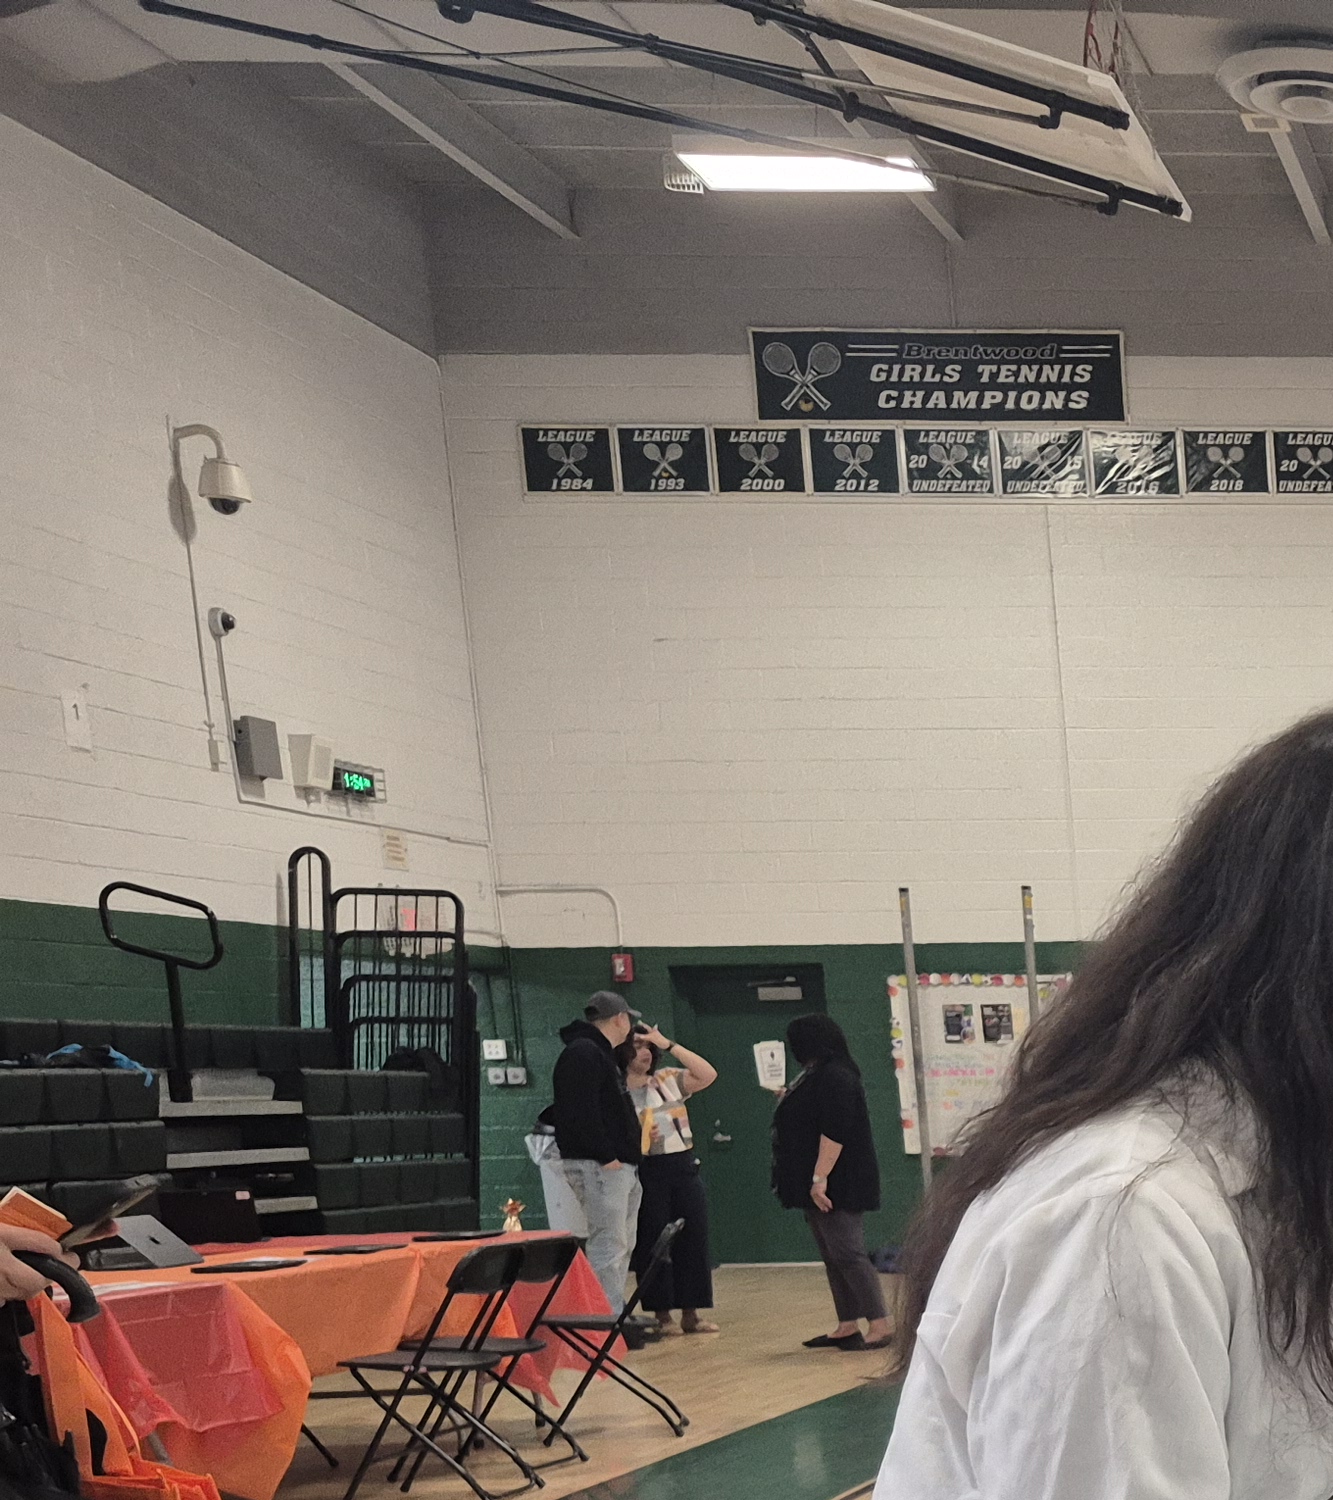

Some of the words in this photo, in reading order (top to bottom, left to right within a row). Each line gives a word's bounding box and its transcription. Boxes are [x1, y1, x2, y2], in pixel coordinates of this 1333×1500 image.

[903, 343, 1057, 359] Brentwood
[869, 364, 961, 382] GIRLS
[977, 365, 1093, 383] TENNIS
[878, 391, 1089, 410] CHAMPIONS
[537, 431, 595, 442] LEAGUE
[633, 430, 691, 442] LEAGUE
[729, 431, 787, 443] LEAGUE
[824, 432, 881, 443] LEAGUE
[919, 432, 976, 443] LEAGUE
[1197, 433, 1252, 445] LEAGUE
[1280, 460, 1298, 472] 20
[551, 478, 593, 490] 1984
[650, 479, 685, 490] 1993
[740, 479, 784, 490] 2000
[835, 480, 879, 491] 2012
[912, 480, 990, 492] UNDEFEATED
[1210, 480, 1243, 491] 2018
